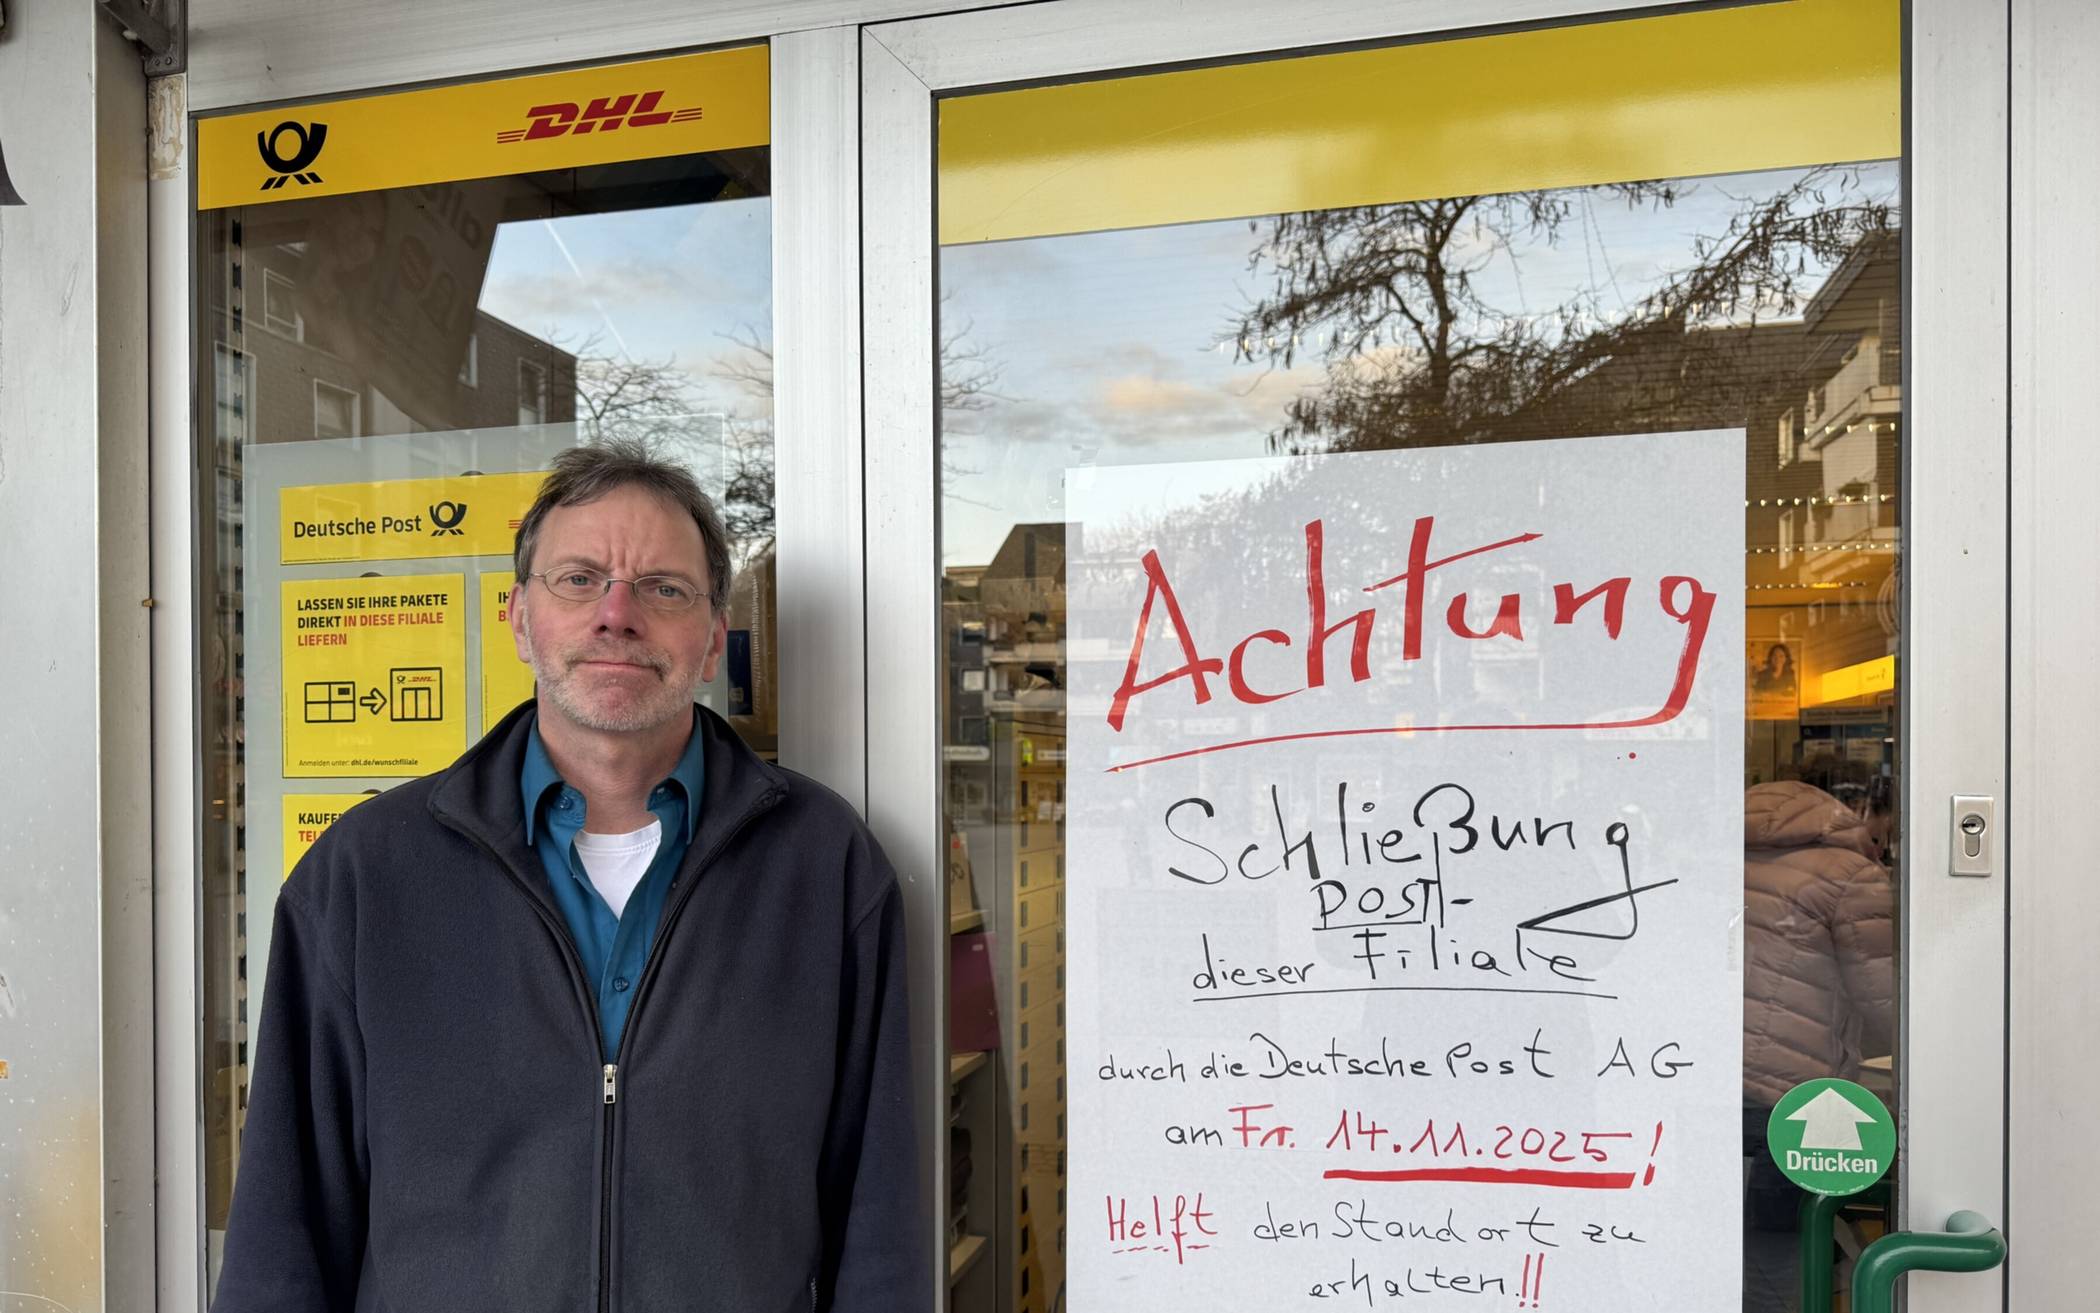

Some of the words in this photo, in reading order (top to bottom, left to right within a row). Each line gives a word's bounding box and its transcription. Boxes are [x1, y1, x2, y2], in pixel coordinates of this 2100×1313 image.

[524, 90, 673, 140] DHL
[293, 517, 376, 538] Deutsche
[381, 515, 422, 533] Post
[297, 597, 344, 611] LASSEN
[346, 596, 365, 609] SIE
[368, 595, 397, 608] IHRE
[400, 593, 448, 607] PAKETE
[297, 616, 341, 629] DIREKT
[343, 614, 357, 627] IN
[360, 613, 395, 626] DIESE
[397, 612, 444, 625] FILIALE
[1106, 515, 1718, 733] Achtung
[297, 633, 347, 647] LIEFERN
[298, 759, 330, 767] Anmelden
[351, 758, 419, 767] dhl.de/wunschfiliale
[1165, 783, 1678, 940] Schließung
[1192, 934, 1315, 991] dieser
[1352, 925, 1596, 983] Filiale
[1098, 1048, 1187, 1084] durch
[1200, 1042, 1250, 1080] die
[1249, 1032, 1434, 1081] Deutsche
[1446, 1028, 1556, 1081] Post
[1165, 1123, 1224, 1148] am
[1228, 1104, 1296, 1150] Fr.
[1786, 1149, 1878, 1174] Drücken
[1106, 1192, 1219, 1264] Helft
[1253, 1202, 1319, 1242] den
[1581, 1225, 1647, 1245] zu
